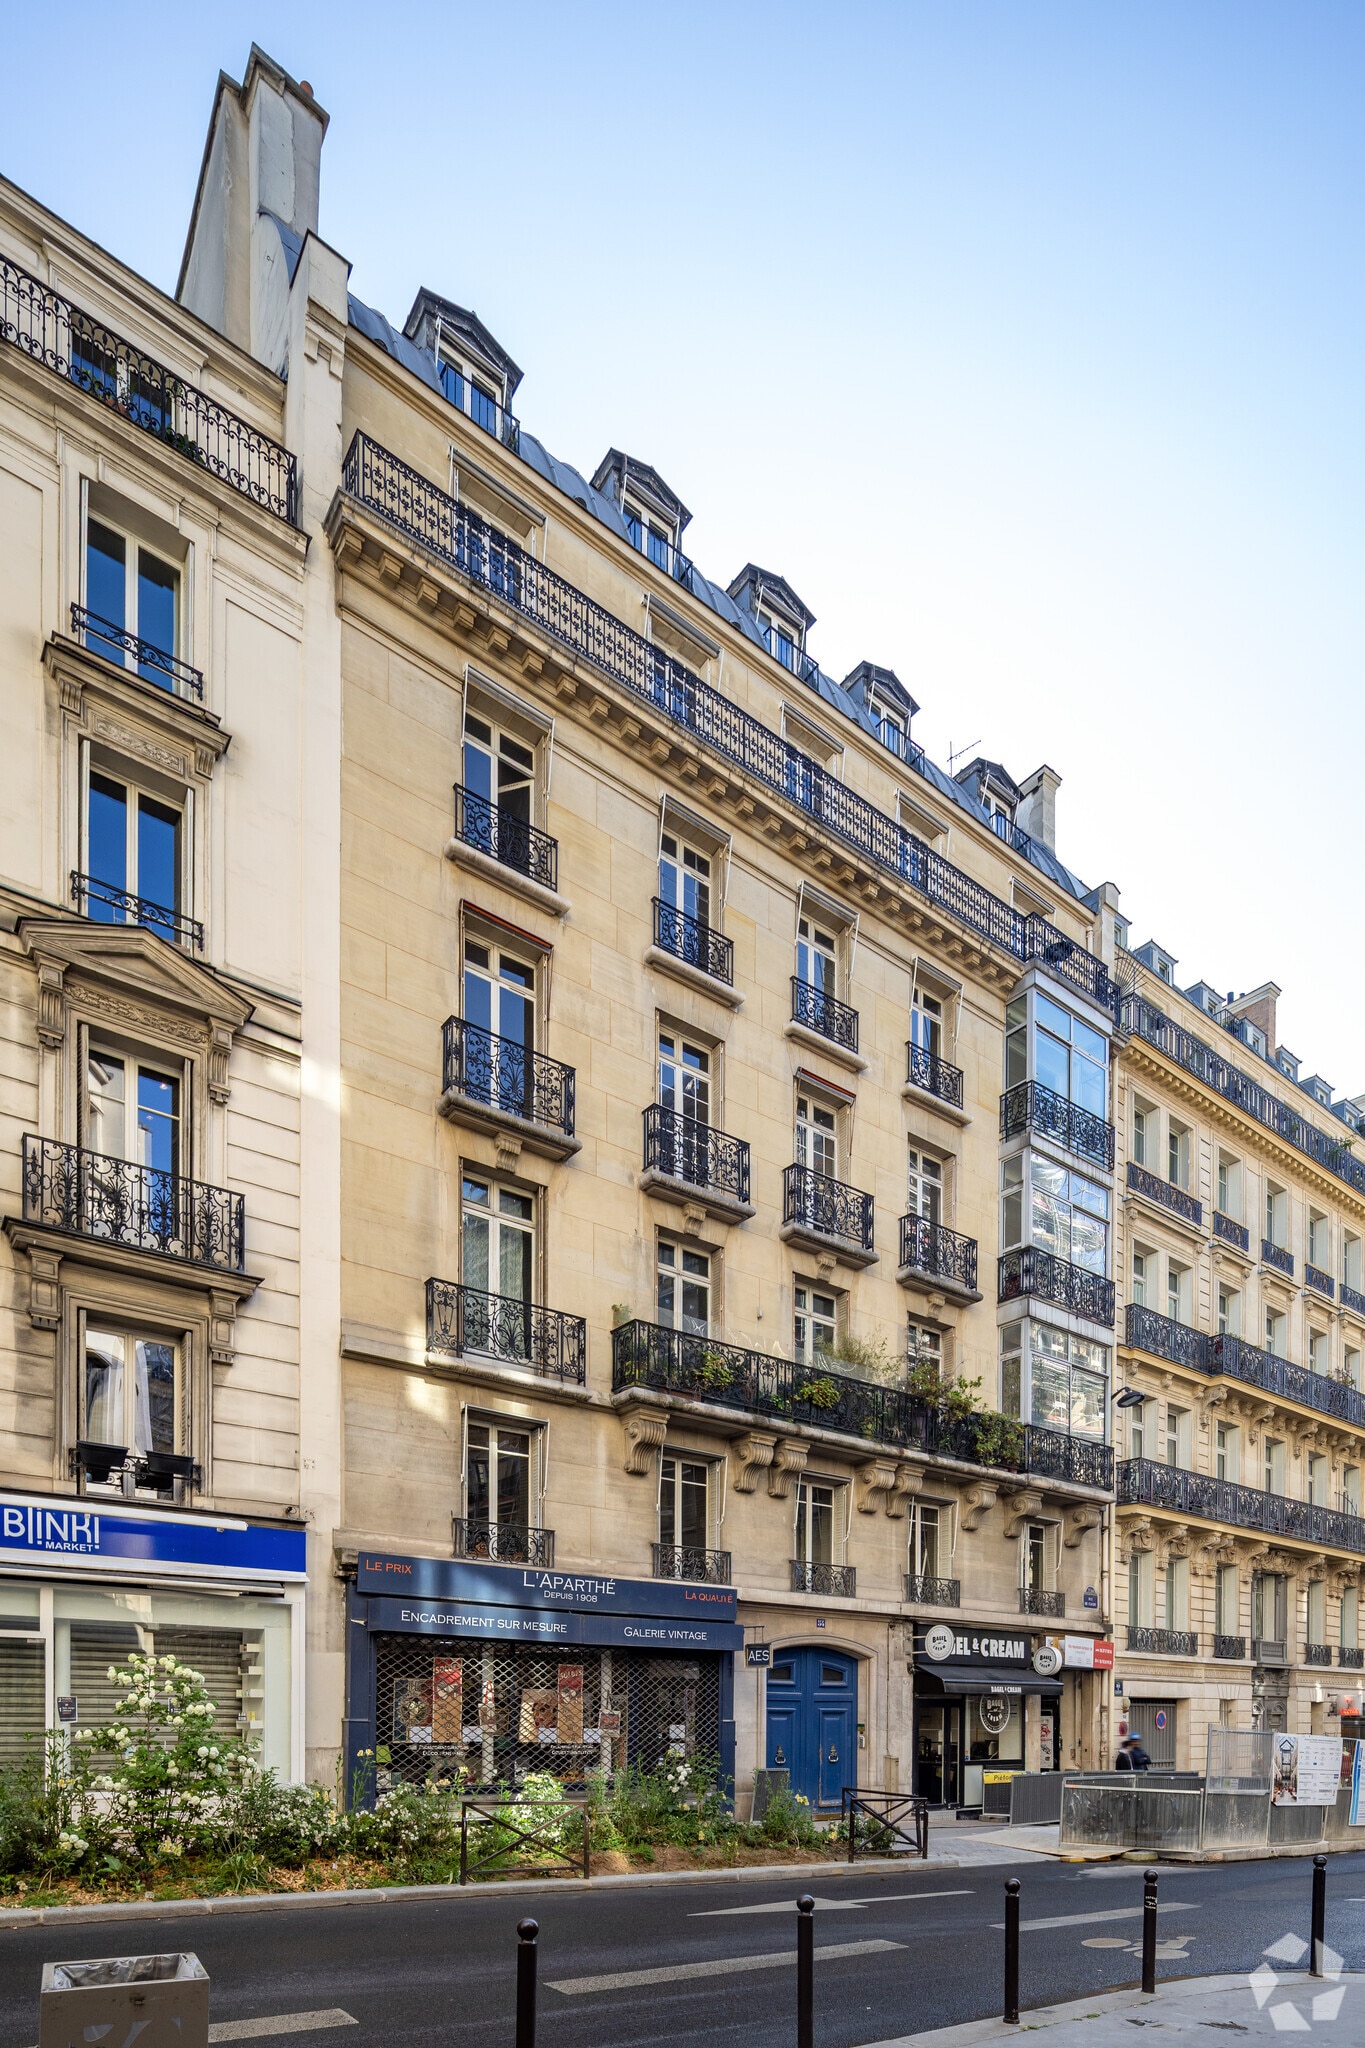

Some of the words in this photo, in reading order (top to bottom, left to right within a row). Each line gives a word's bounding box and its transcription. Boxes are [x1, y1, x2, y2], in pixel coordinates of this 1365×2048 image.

[45, 1541, 93, 1552] MARKET
[365, 1559, 382, 1572] LE
[385, 1562, 412, 1574] PRIX
[523, 1571, 616, 1595] L'APARTHÉ
[544, 1590, 574, 1601] DEPUIS
[576, 1593, 598, 1603] 1908
[685, 1590, 697, 1600] LA
[401, 1610, 495, 1628] ENCADREMENT
[497, 1619, 520, 1630] SUR
[523, 1621, 568, 1633] MESURE
[624, 1626, 666, 1639] GALERIE
[668, 1629, 708, 1641] VINTAGE
[972, 1638, 979, 1653] &
[980, 1637, 1025, 1659] CREAM
[748, 1649, 770, 1662] AES
[986, 1699, 1004, 1710] BAGEL
